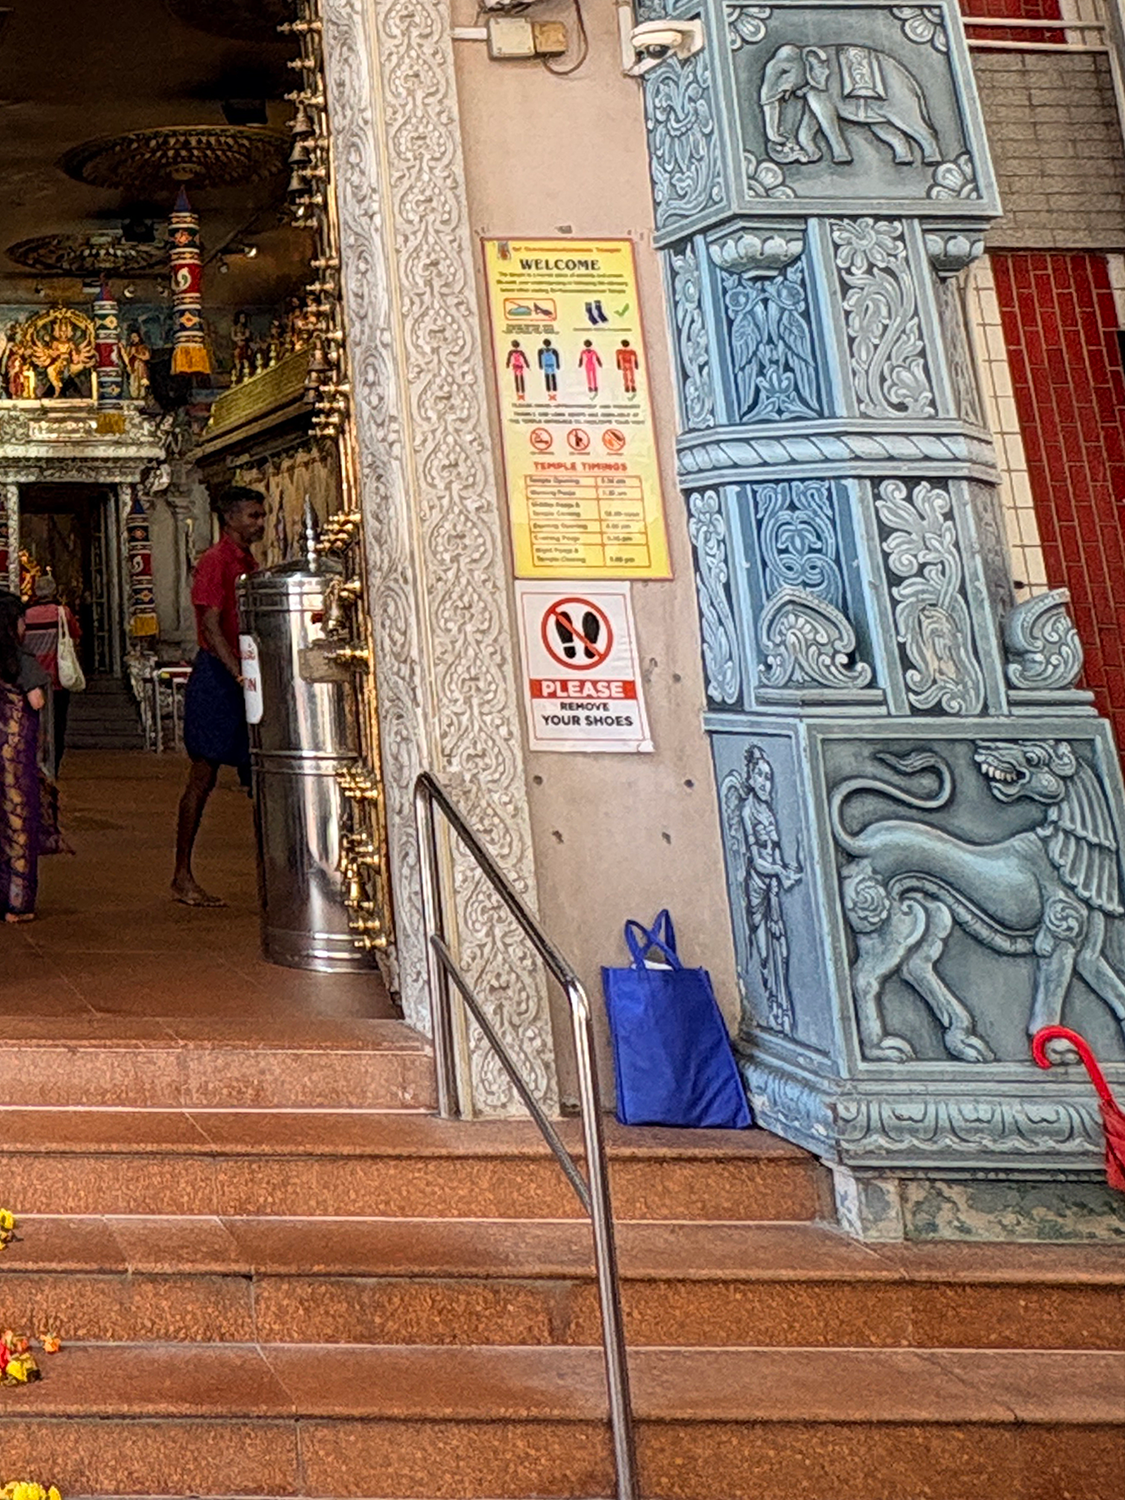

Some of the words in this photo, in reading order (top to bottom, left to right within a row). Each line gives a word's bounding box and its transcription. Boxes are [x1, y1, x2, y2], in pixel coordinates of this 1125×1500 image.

[520, 259, 601, 270] WELCOME
[534, 462, 577, 470] TEMPLE
[582, 462, 627, 471] TIMINGS
[541, 681, 625, 697] PLEASE
[560, 702, 610, 711] REMOVE
[542, 715, 581, 727] YOUR
[585, 716, 634, 727] SHOES
